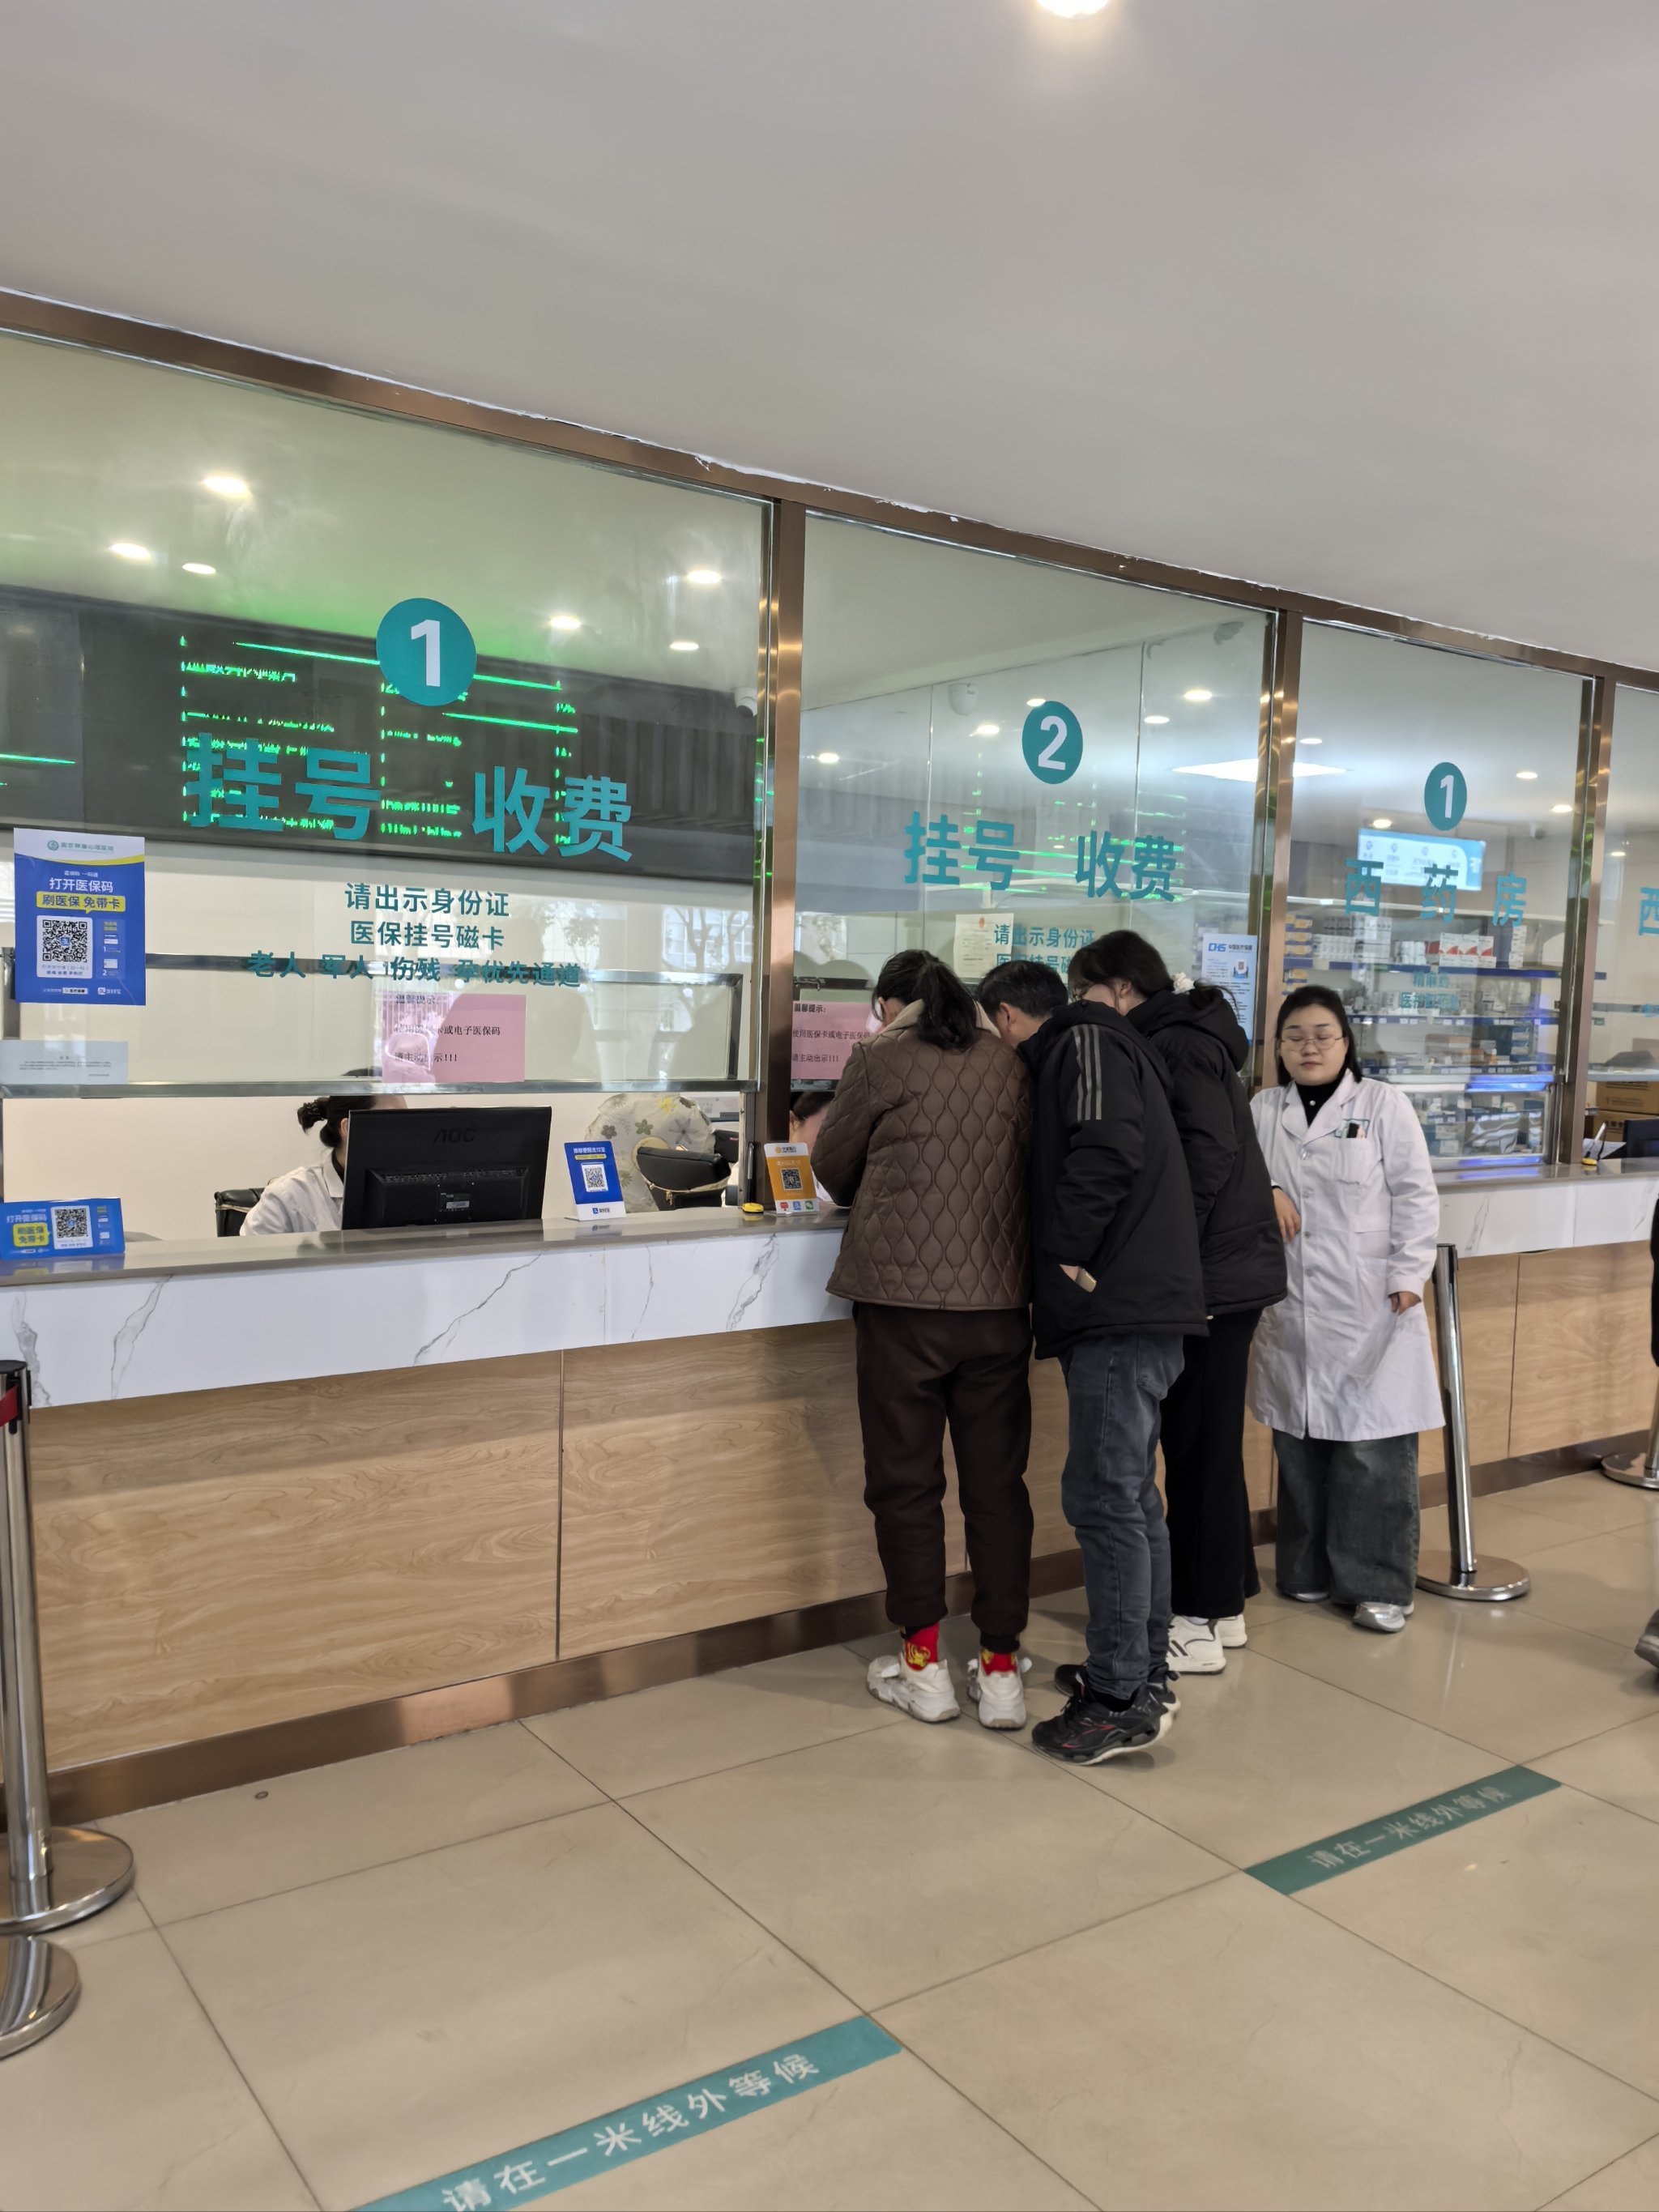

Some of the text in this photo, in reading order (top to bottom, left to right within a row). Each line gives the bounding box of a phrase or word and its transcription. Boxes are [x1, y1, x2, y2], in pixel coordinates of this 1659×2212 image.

[411, 619, 441, 687] 1
[1038, 716, 1068, 770] 2
[184, 732, 632, 861] 挂号 收费
[1439, 774, 1454, 819] 1
[904, 811, 1176, 901] 挂号 收费
[42, 894, 121, 909] 刷医保 免带卡
[49, 877, 113, 893] 打开医保码
[344, 883, 510, 917] 请出示身份证
[350, 920, 505, 951] 医保挂号磁卡
[246, 950, 305, 980] 老人
[433, 1127, 478, 1144] AOC
[441, 2052, 820, 2212] 请在一米线外等候
